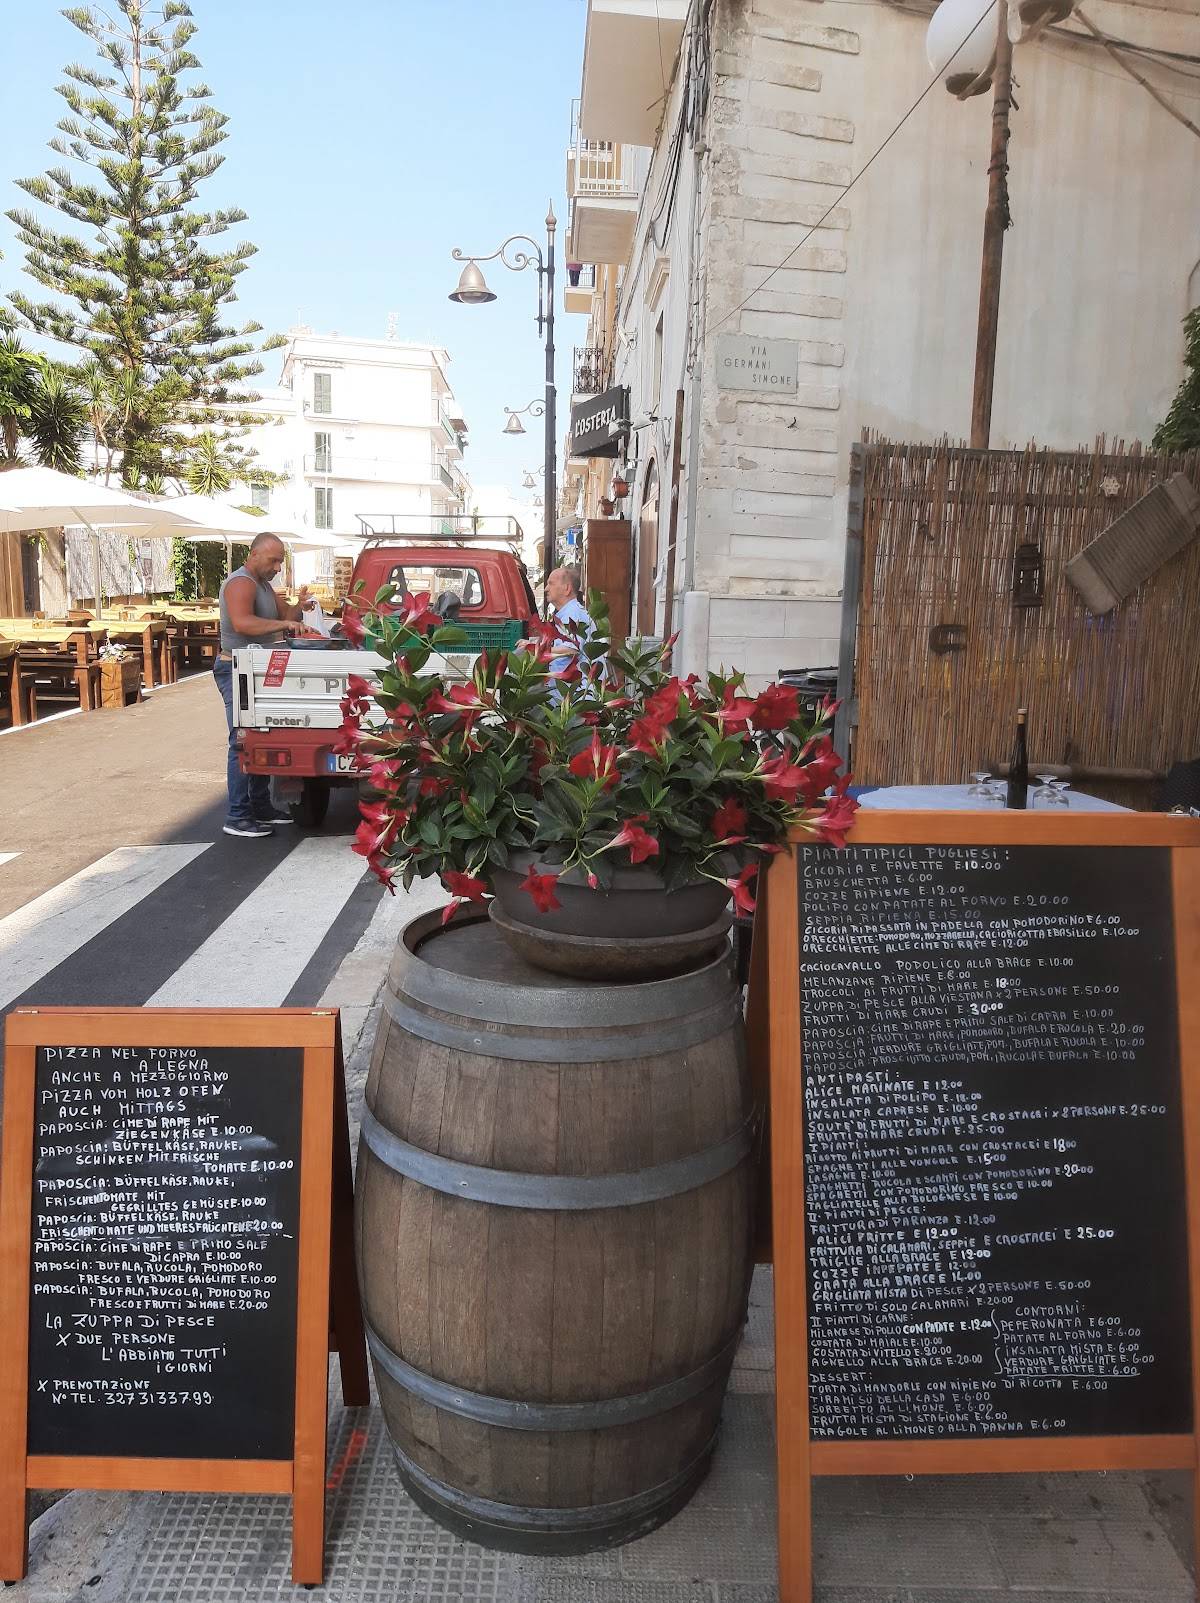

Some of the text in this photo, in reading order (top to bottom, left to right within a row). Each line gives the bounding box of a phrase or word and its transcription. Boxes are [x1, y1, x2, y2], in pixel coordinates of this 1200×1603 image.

[751, 346, 766, 356] VIA
[725, 358, 770, 369] GERMANI
[753, 374, 791, 384] SIMONE
[575, 405, 615, 438] L'OSTERIA
[266, 717, 300, 725] Porter
[112, 1048, 138, 1059] NEL
[149, 1049, 197, 1059] FORNO
[158, 1059, 208, 1071] LEGNA
[52, 1071, 101, 1084] ANCHE
[100, 1088, 127, 1100] VOM
[137, 1087, 171, 1098] HOLZ
[179, 1084, 224, 1096] OFEN
[60, 1105, 101, 1118] AUCH
[161, 1118, 190, 1128] RAPE
[202, 1162, 247, 1173] TOMATE
[183, 1197, 230, 1209] GEMÜSE
[182, 1212, 219, 1220] RAUKE
[138, 1224, 156, 1234] UND
[144, 1241, 171, 1251] RAPE
[236, 1239, 268, 1249] SALE
[164, 1253, 199, 1262] CAPRA
[202, 1263, 262, 1272] POMODORO
[78, 1275, 120, 1284] FRESCO
[136, 1275, 184, 1284] VERDURE
[208, 1288, 270, 1299] POMODORO
[90, 1298, 134, 1309] FRESCO
[200, 1300, 225, 1309] MARE
[46, 1313, 215, 1328] LA ZUPPA PESCE
[76, 1333, 176, 1344] DUE PERSONE
